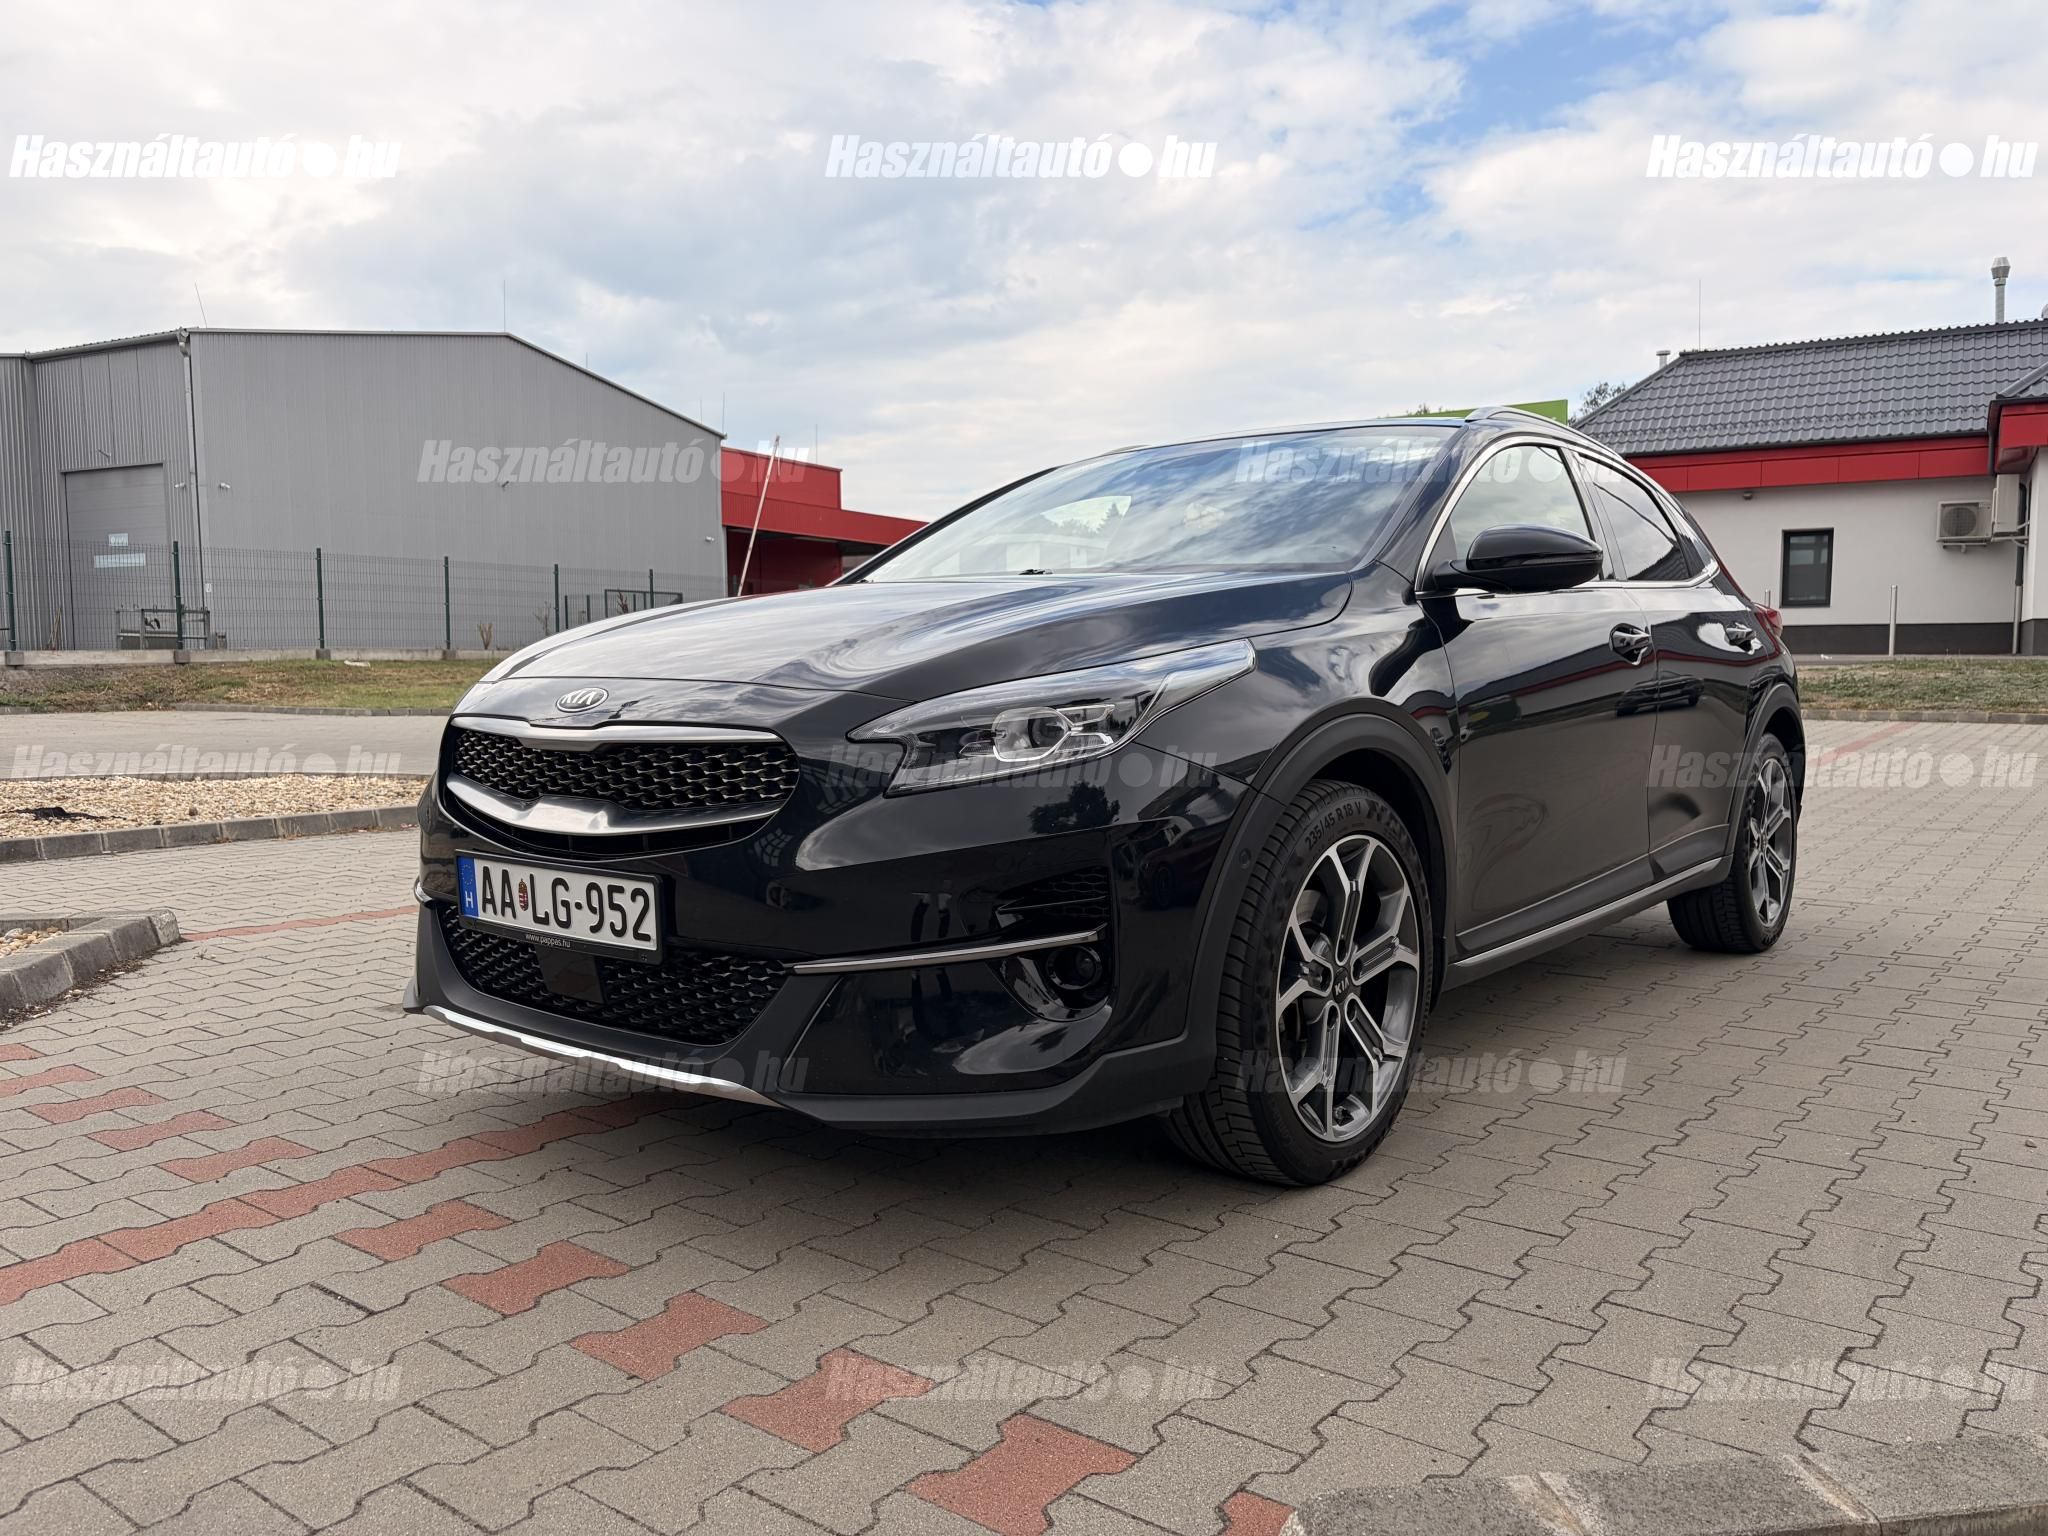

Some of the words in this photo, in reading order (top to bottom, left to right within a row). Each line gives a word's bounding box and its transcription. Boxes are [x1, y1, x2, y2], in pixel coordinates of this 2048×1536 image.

[561, 690, 597, 705] KIA
[465, 890, 474, 909] H
[525, 933, 571, 948] www.pappas.hu
[1334, 975, 1350, 996] KIA
